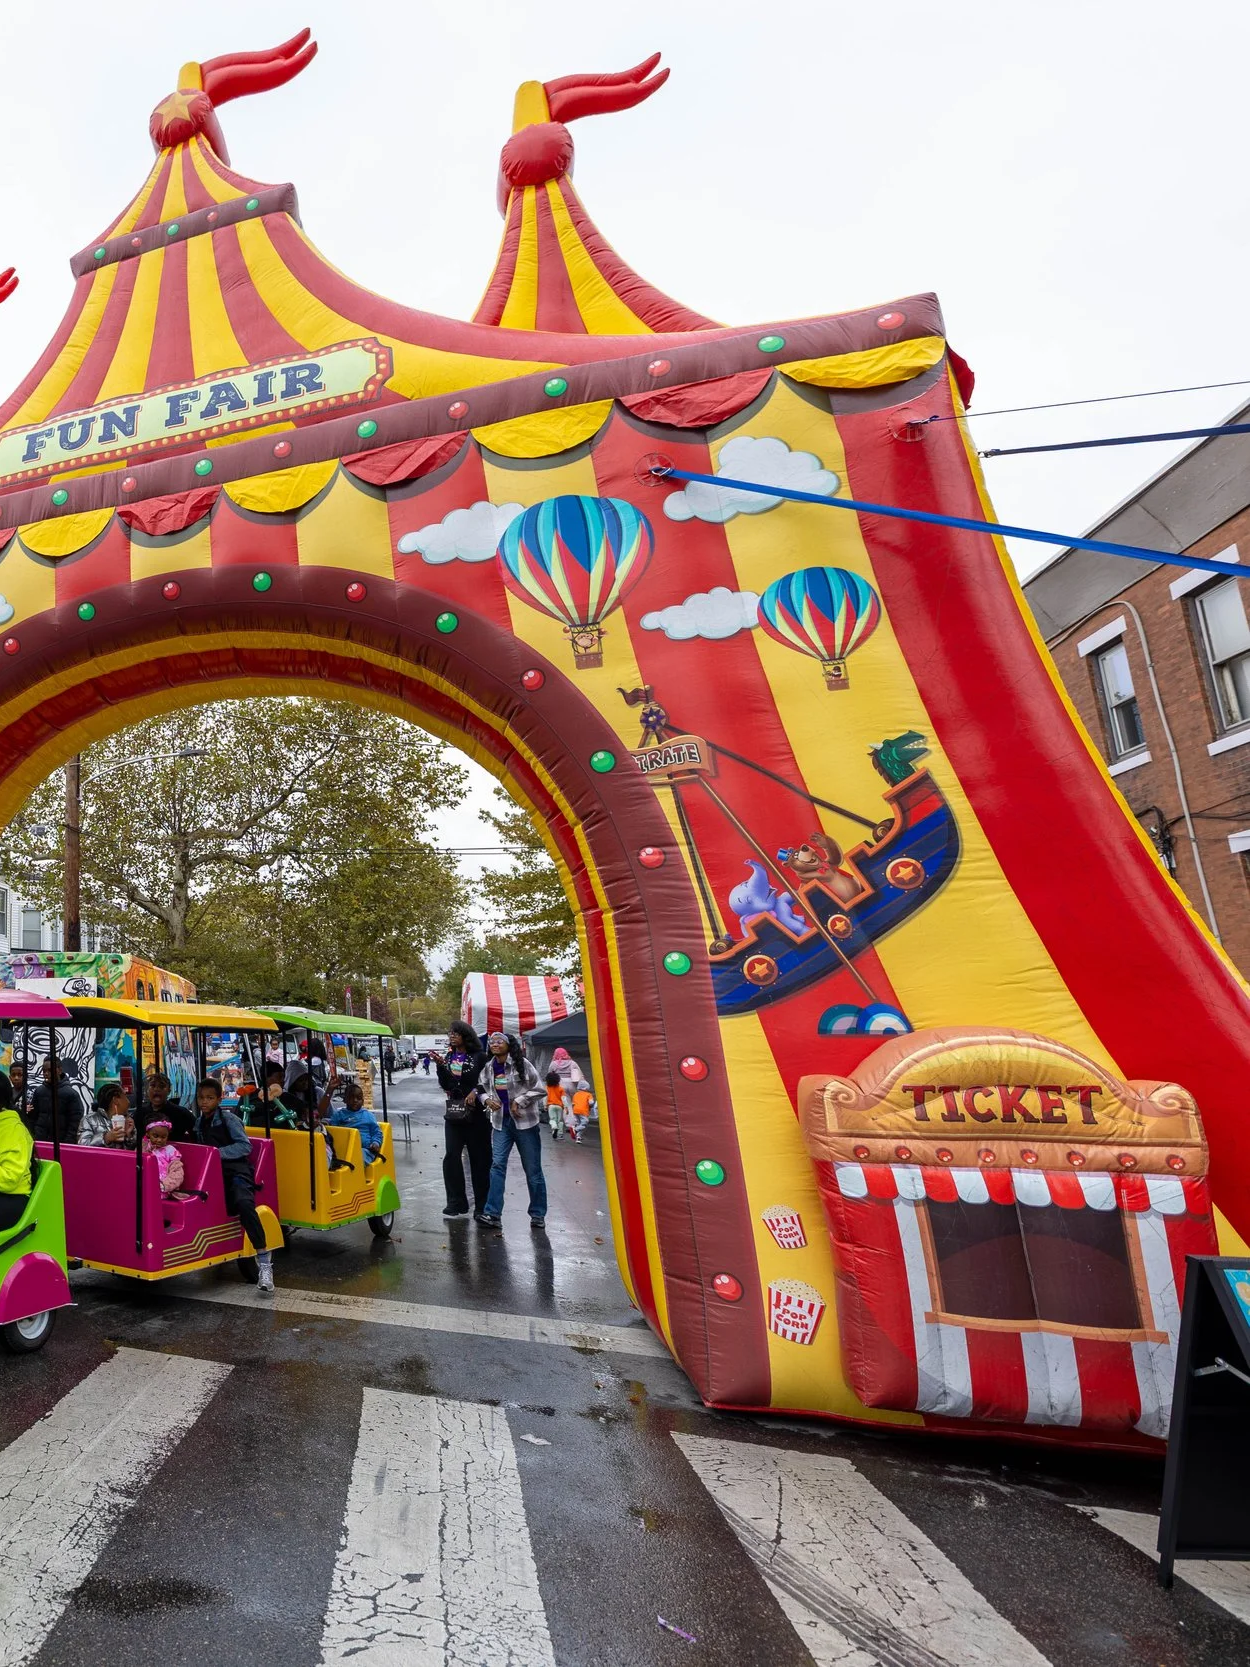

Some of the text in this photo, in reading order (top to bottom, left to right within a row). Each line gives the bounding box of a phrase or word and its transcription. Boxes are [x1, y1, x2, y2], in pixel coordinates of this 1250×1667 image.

[21, 361, 325, 464] FUN FAIR
[633, 743, 701, 774] IRATE
[902, 1084, 1103, 1125] TICKET
[777, 1230, 800, 1239] CORN
[778, 1225, 796, 1233] POP
[775, 1313, 810, 1330] CORN
[781, 1307, 807, 1321] POP
